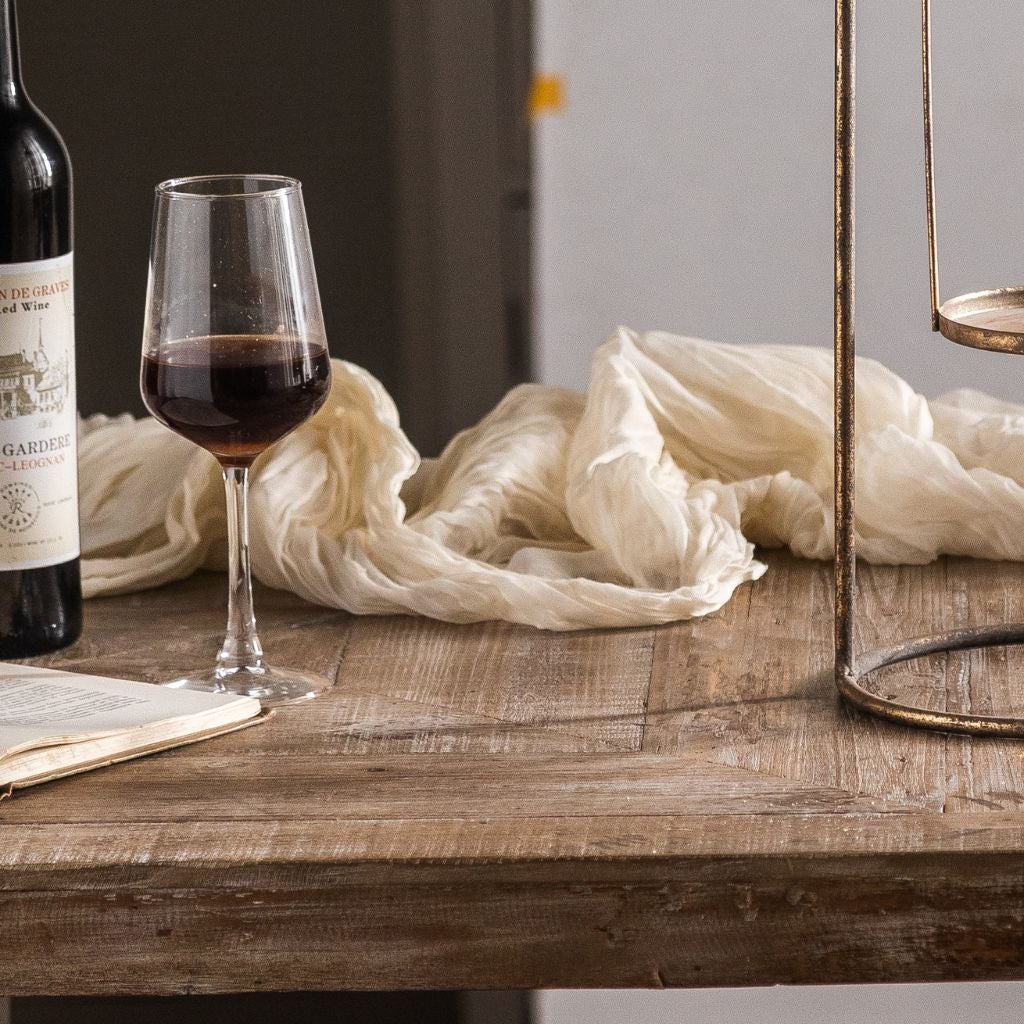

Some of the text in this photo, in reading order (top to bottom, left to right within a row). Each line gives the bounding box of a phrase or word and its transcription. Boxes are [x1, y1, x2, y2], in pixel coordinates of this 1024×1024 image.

[11, 287, 30, 300] DE
[32, 279, 70, 297] GRAVES
[0, 301, 50, 314] ed Wine
